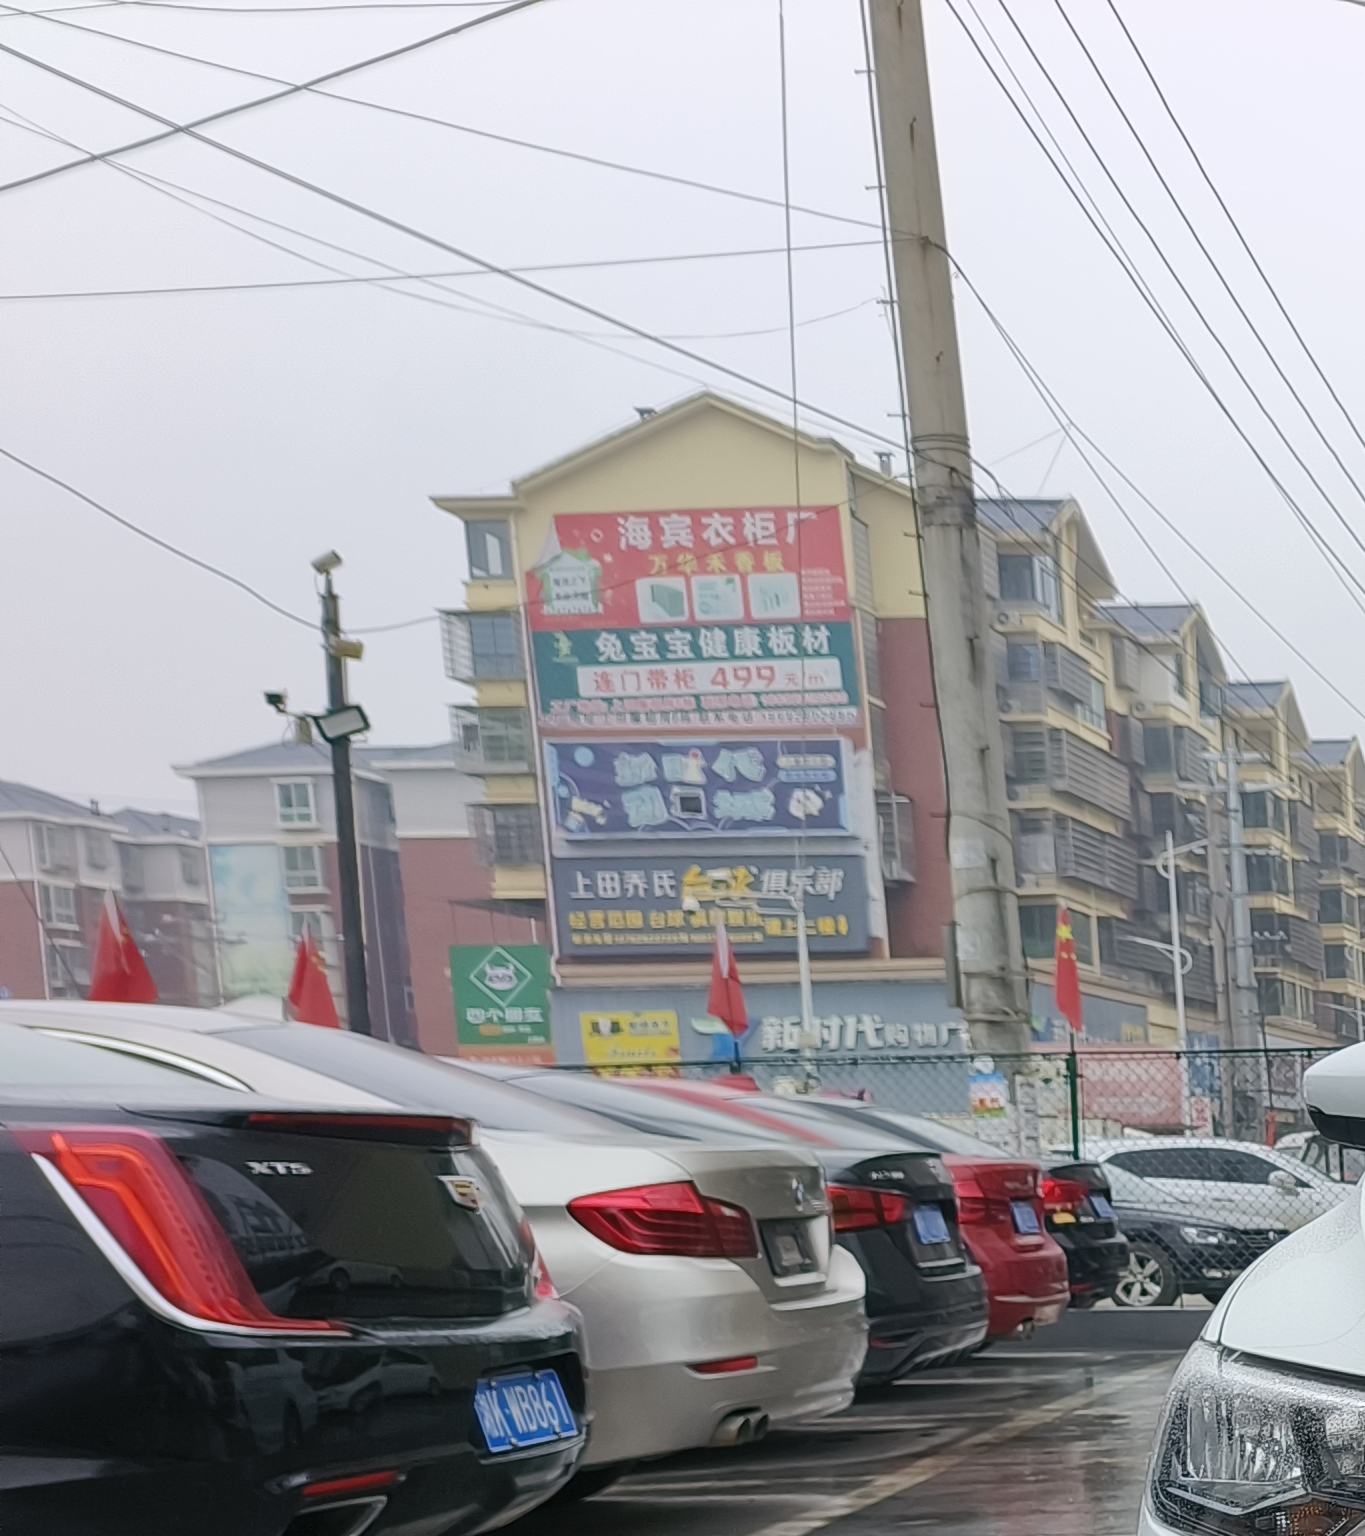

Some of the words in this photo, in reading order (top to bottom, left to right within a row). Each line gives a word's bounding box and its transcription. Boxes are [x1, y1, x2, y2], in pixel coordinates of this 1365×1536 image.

[616, 511, 817, 551] 海宾衣柜厂
[594, 624, 831, 663] 兔宝宝健康板材
[710, 664, 777, 690] 499
